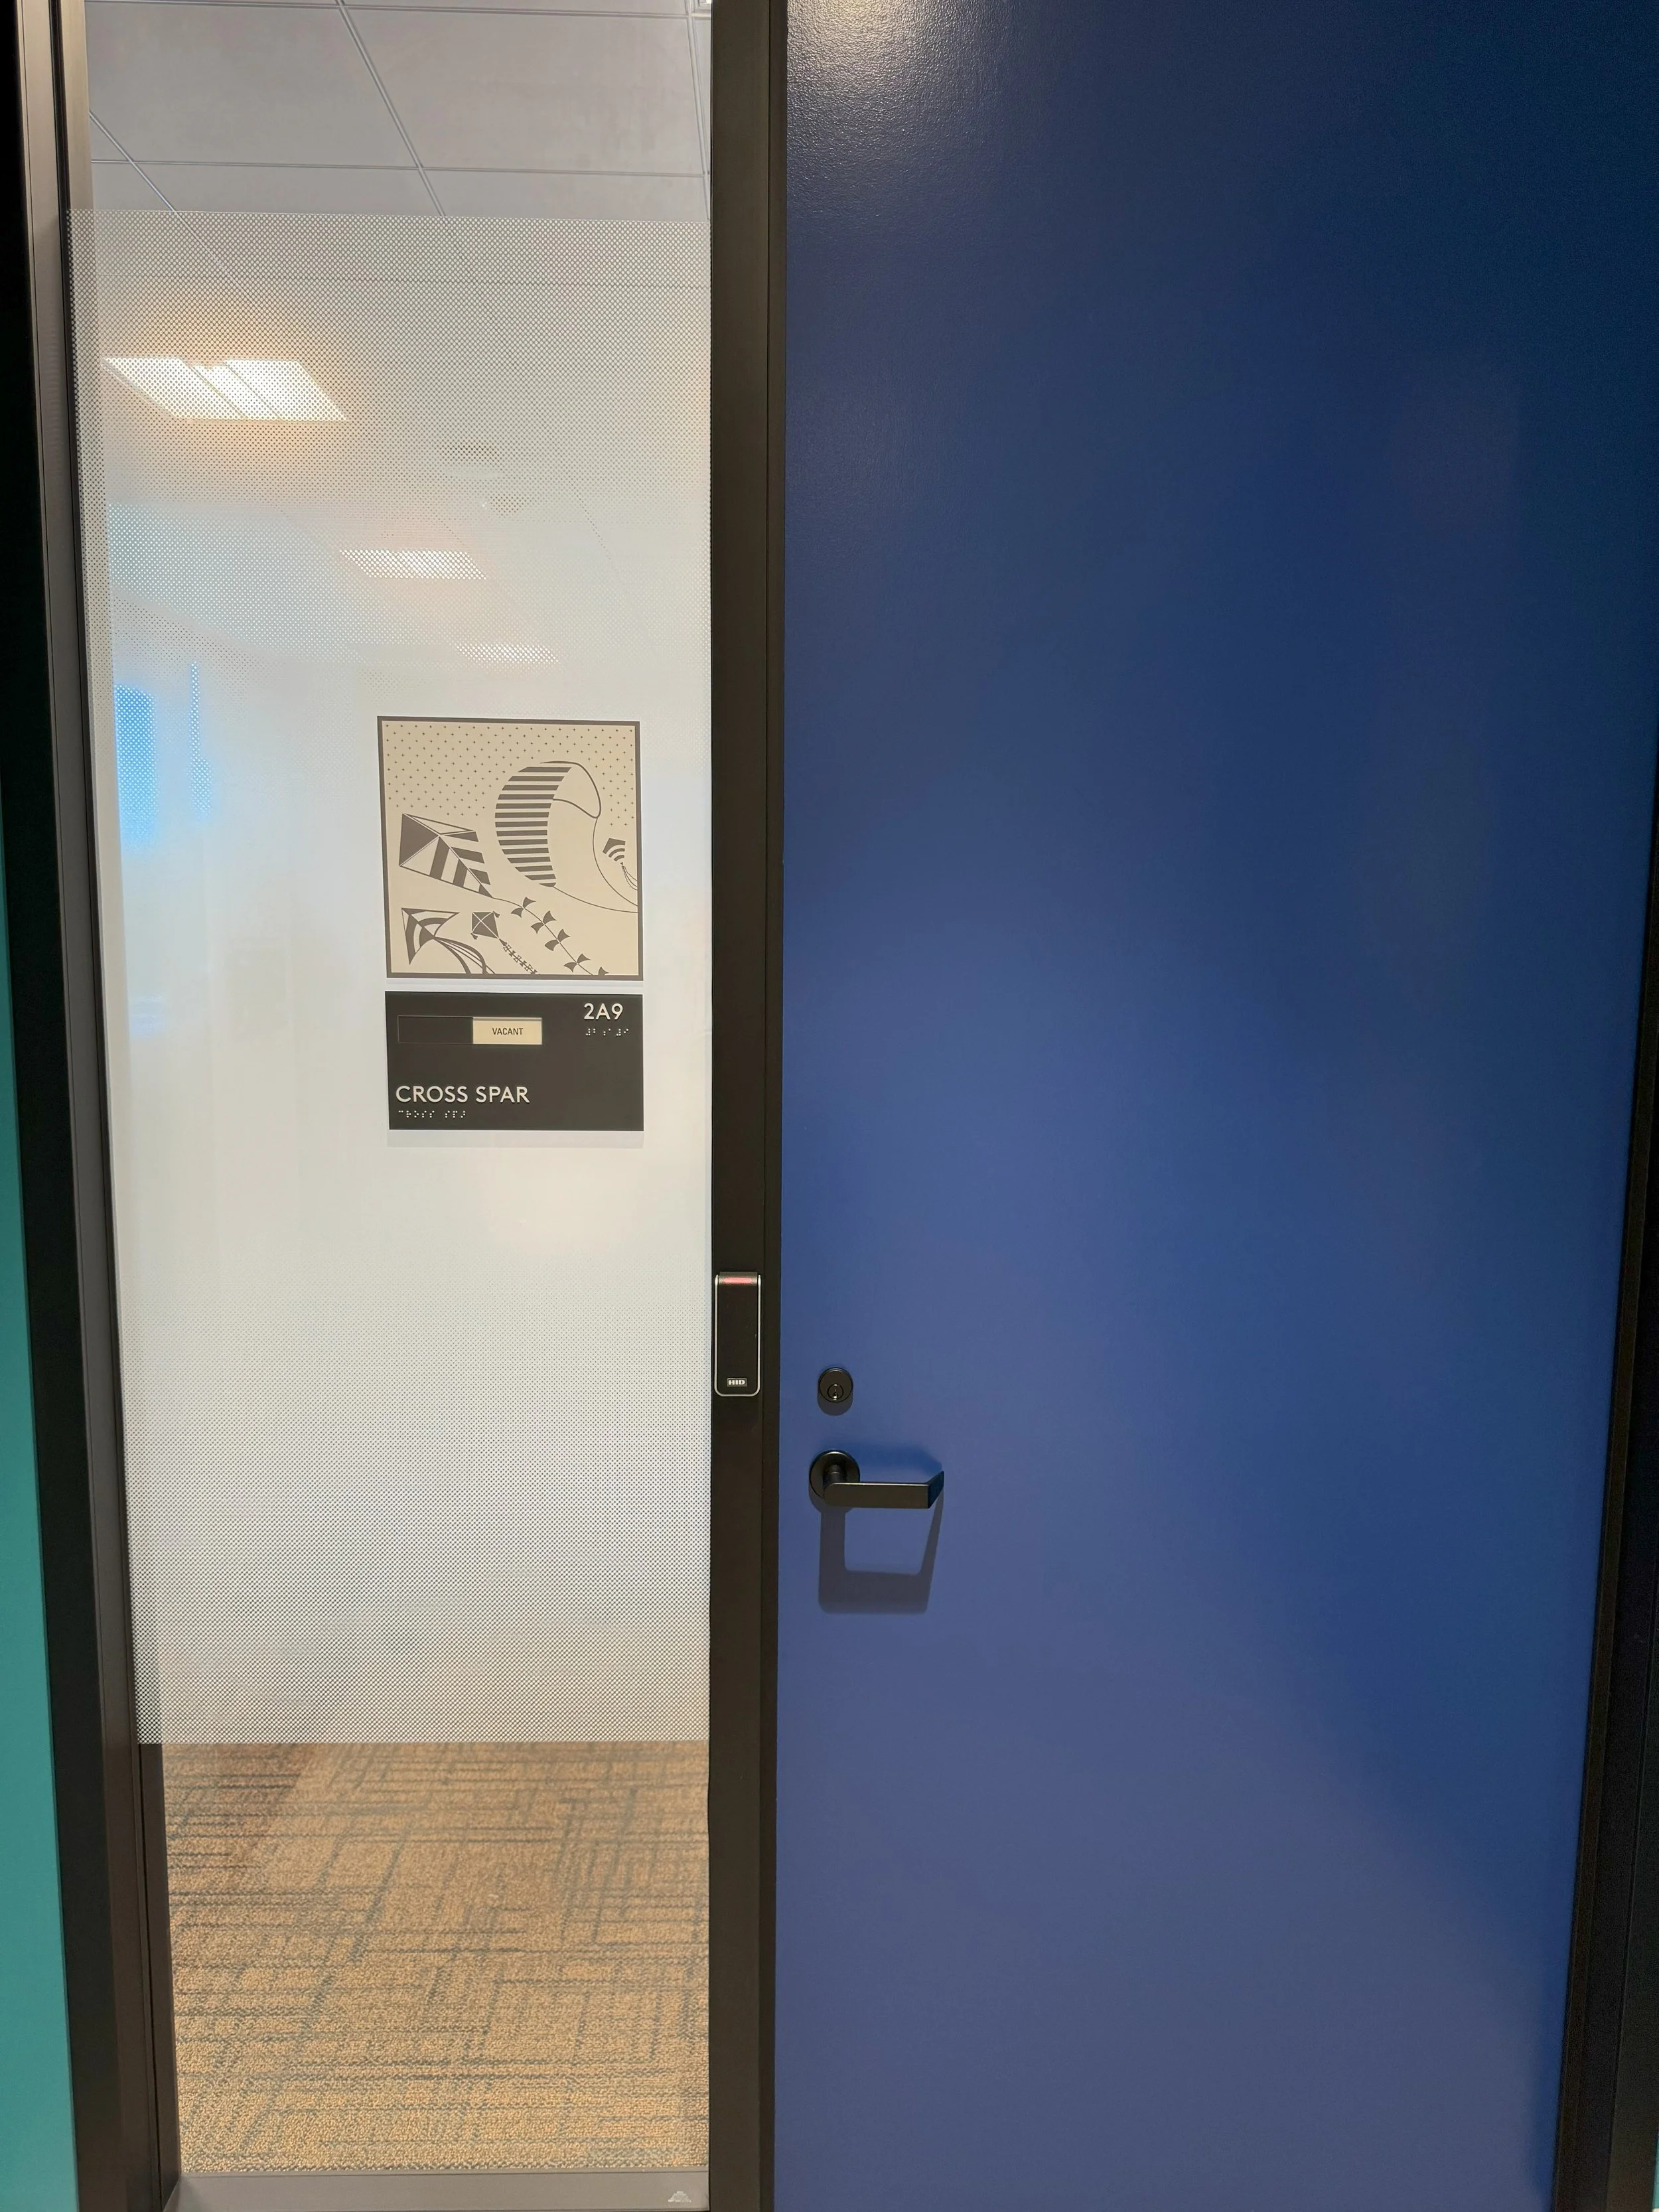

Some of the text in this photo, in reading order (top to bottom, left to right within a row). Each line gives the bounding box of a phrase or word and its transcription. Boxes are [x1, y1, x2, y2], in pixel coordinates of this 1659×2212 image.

[584, 1003, 623, 1020] 2A9
[396, 1085, 530, 1103] CROSS SPAR
